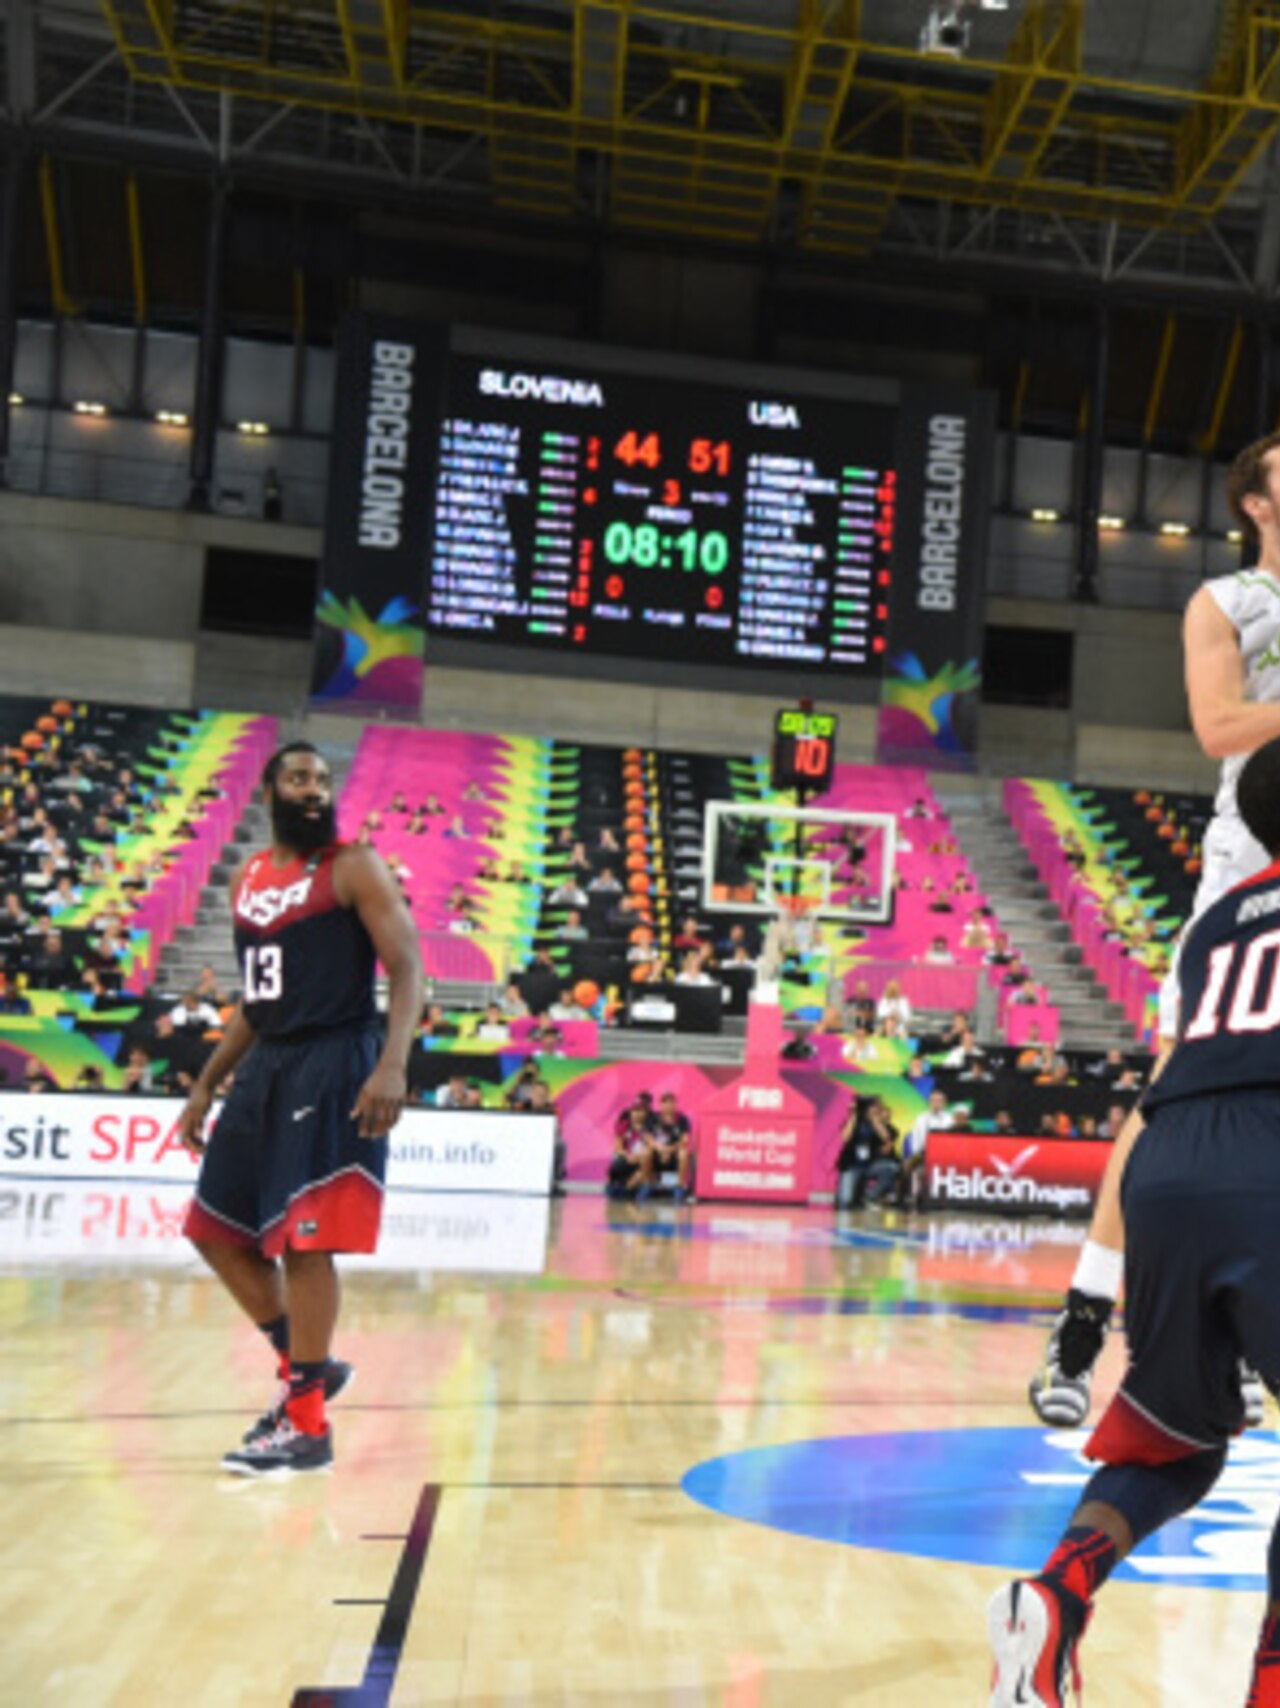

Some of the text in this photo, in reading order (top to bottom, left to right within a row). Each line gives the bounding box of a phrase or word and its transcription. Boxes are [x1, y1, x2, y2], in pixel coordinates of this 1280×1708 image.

[478, 369, 604, 406] SLOVENIA
[747, 401, 800, 429] USA
[358, 341, 415, 547] BARCELONA
[613, 430, 731, 477] 44 51
[919, 415, 966, 610] BARCELONA
[604, 521, 729, 575] 08:10
[795, 738, 829, 775] 10
[237, 876, 314, 928] USA
[244, 944, 283, 1004] 13
[738, 1085, 783, 1111] FIBA
[89, 1114, 216, 1163] SPA
[716, 1145, 796, 1168] World Cup
[717, 1125, 798, 1148] Basketball
